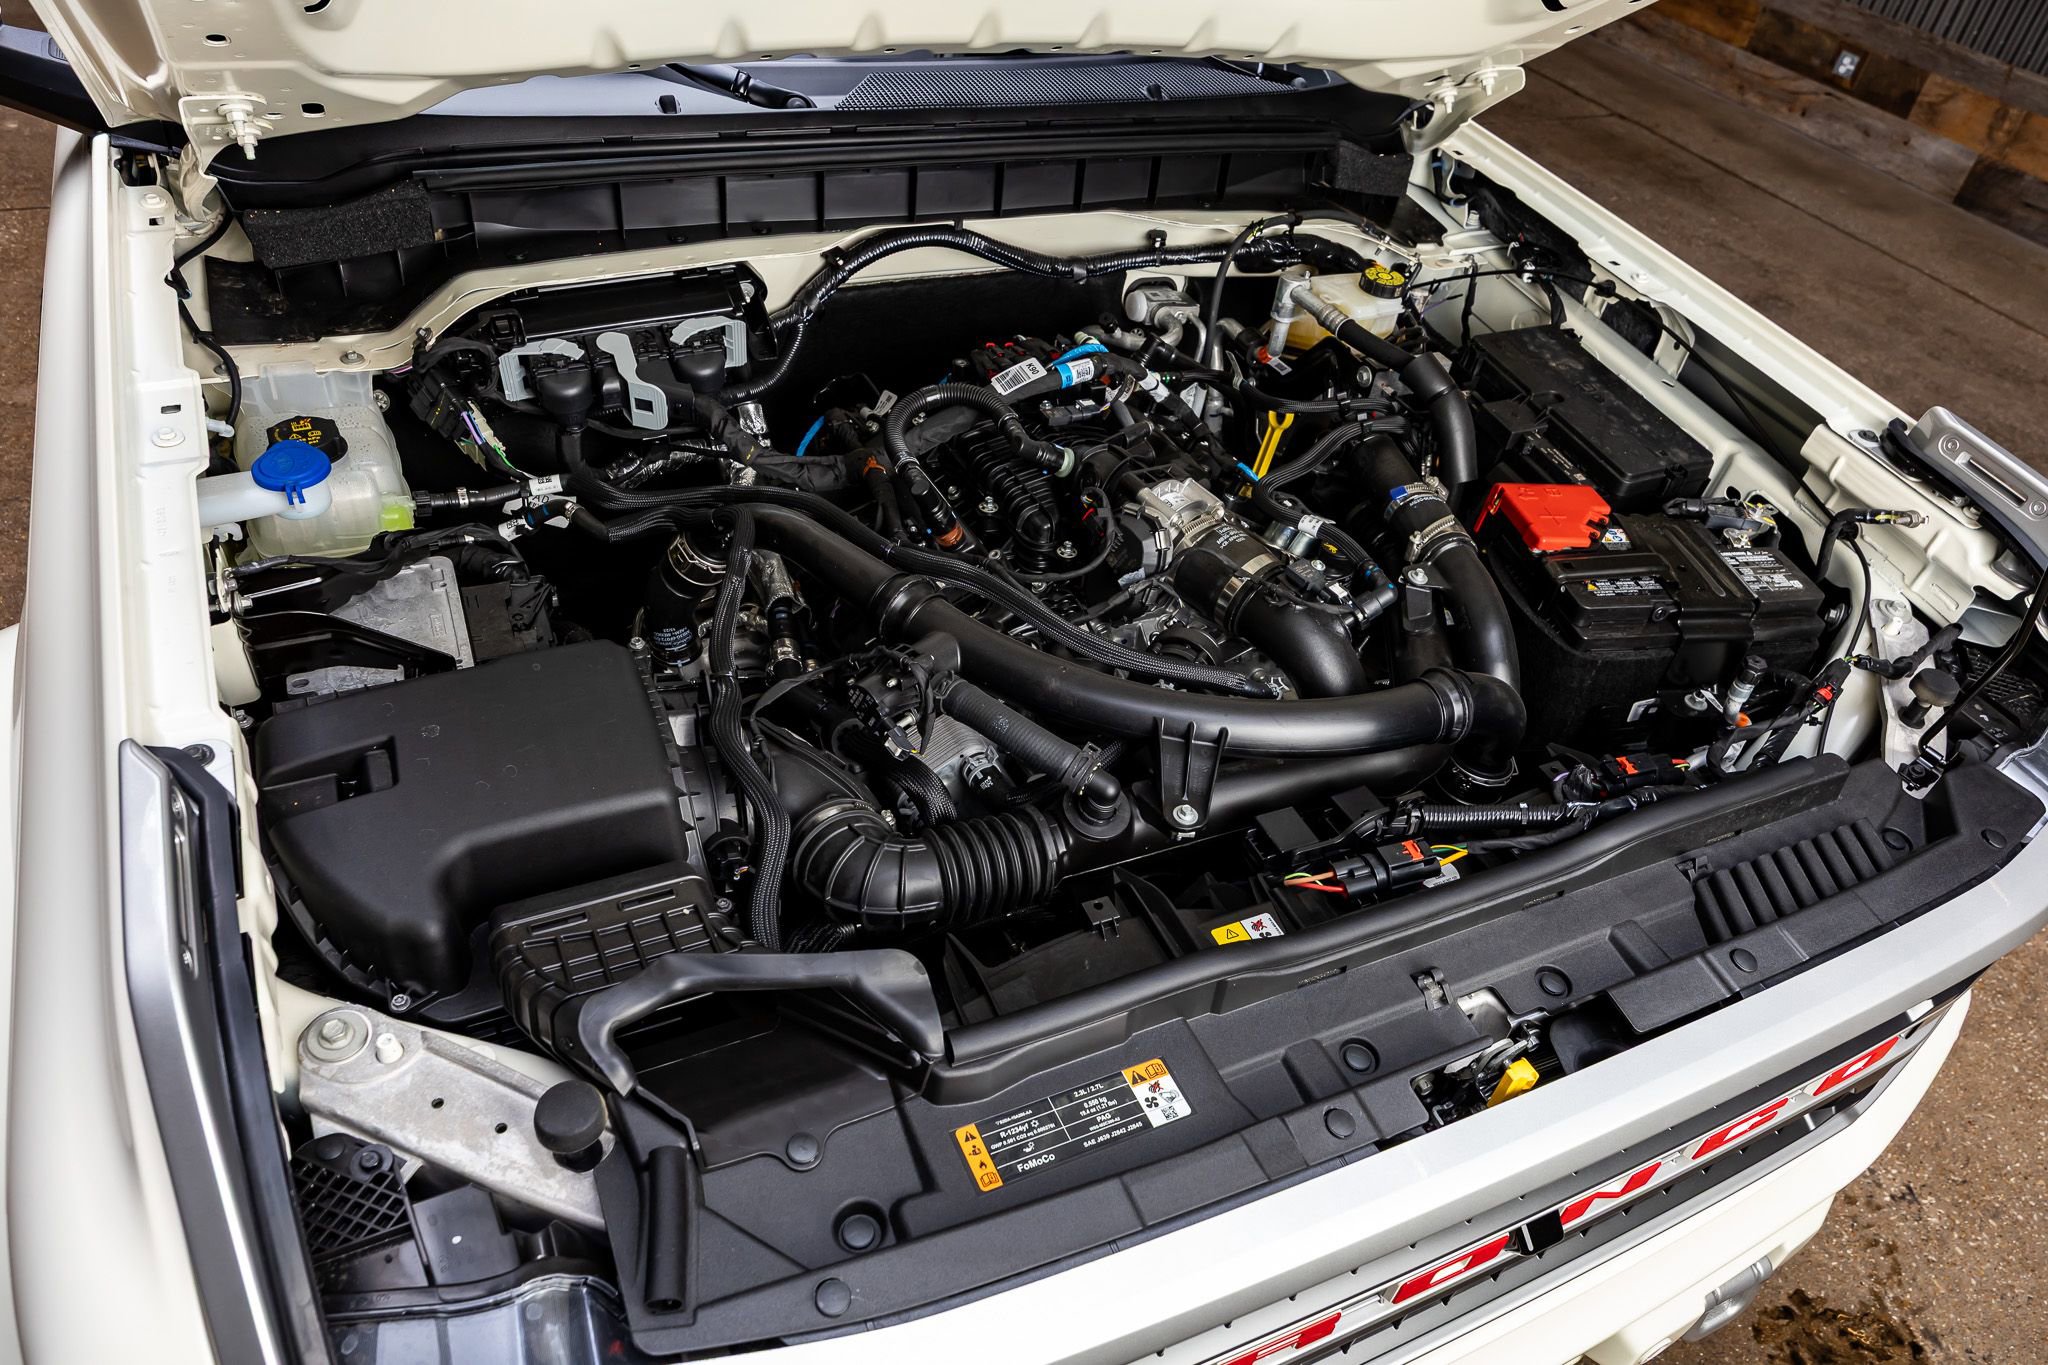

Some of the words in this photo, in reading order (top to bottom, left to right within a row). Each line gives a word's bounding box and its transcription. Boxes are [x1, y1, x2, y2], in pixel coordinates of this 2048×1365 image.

[1026, 362, 1040, 375] K90
[1073, 1089, 1087, 1098] 2.3L
[1090, 1083, 1104, 1092] 2.7L
[1096, 1112, 1112, 1123] PAG
[999, 1122, 1029, 1139] R-1234yf
[990, 1141, 1003, 1150] GWP
[1083, 1138, 1097, 1148] SAE
[1097, 1133, 1111, 1143] J639
[1016, 1153, 1056, 1172] FoMoCo
